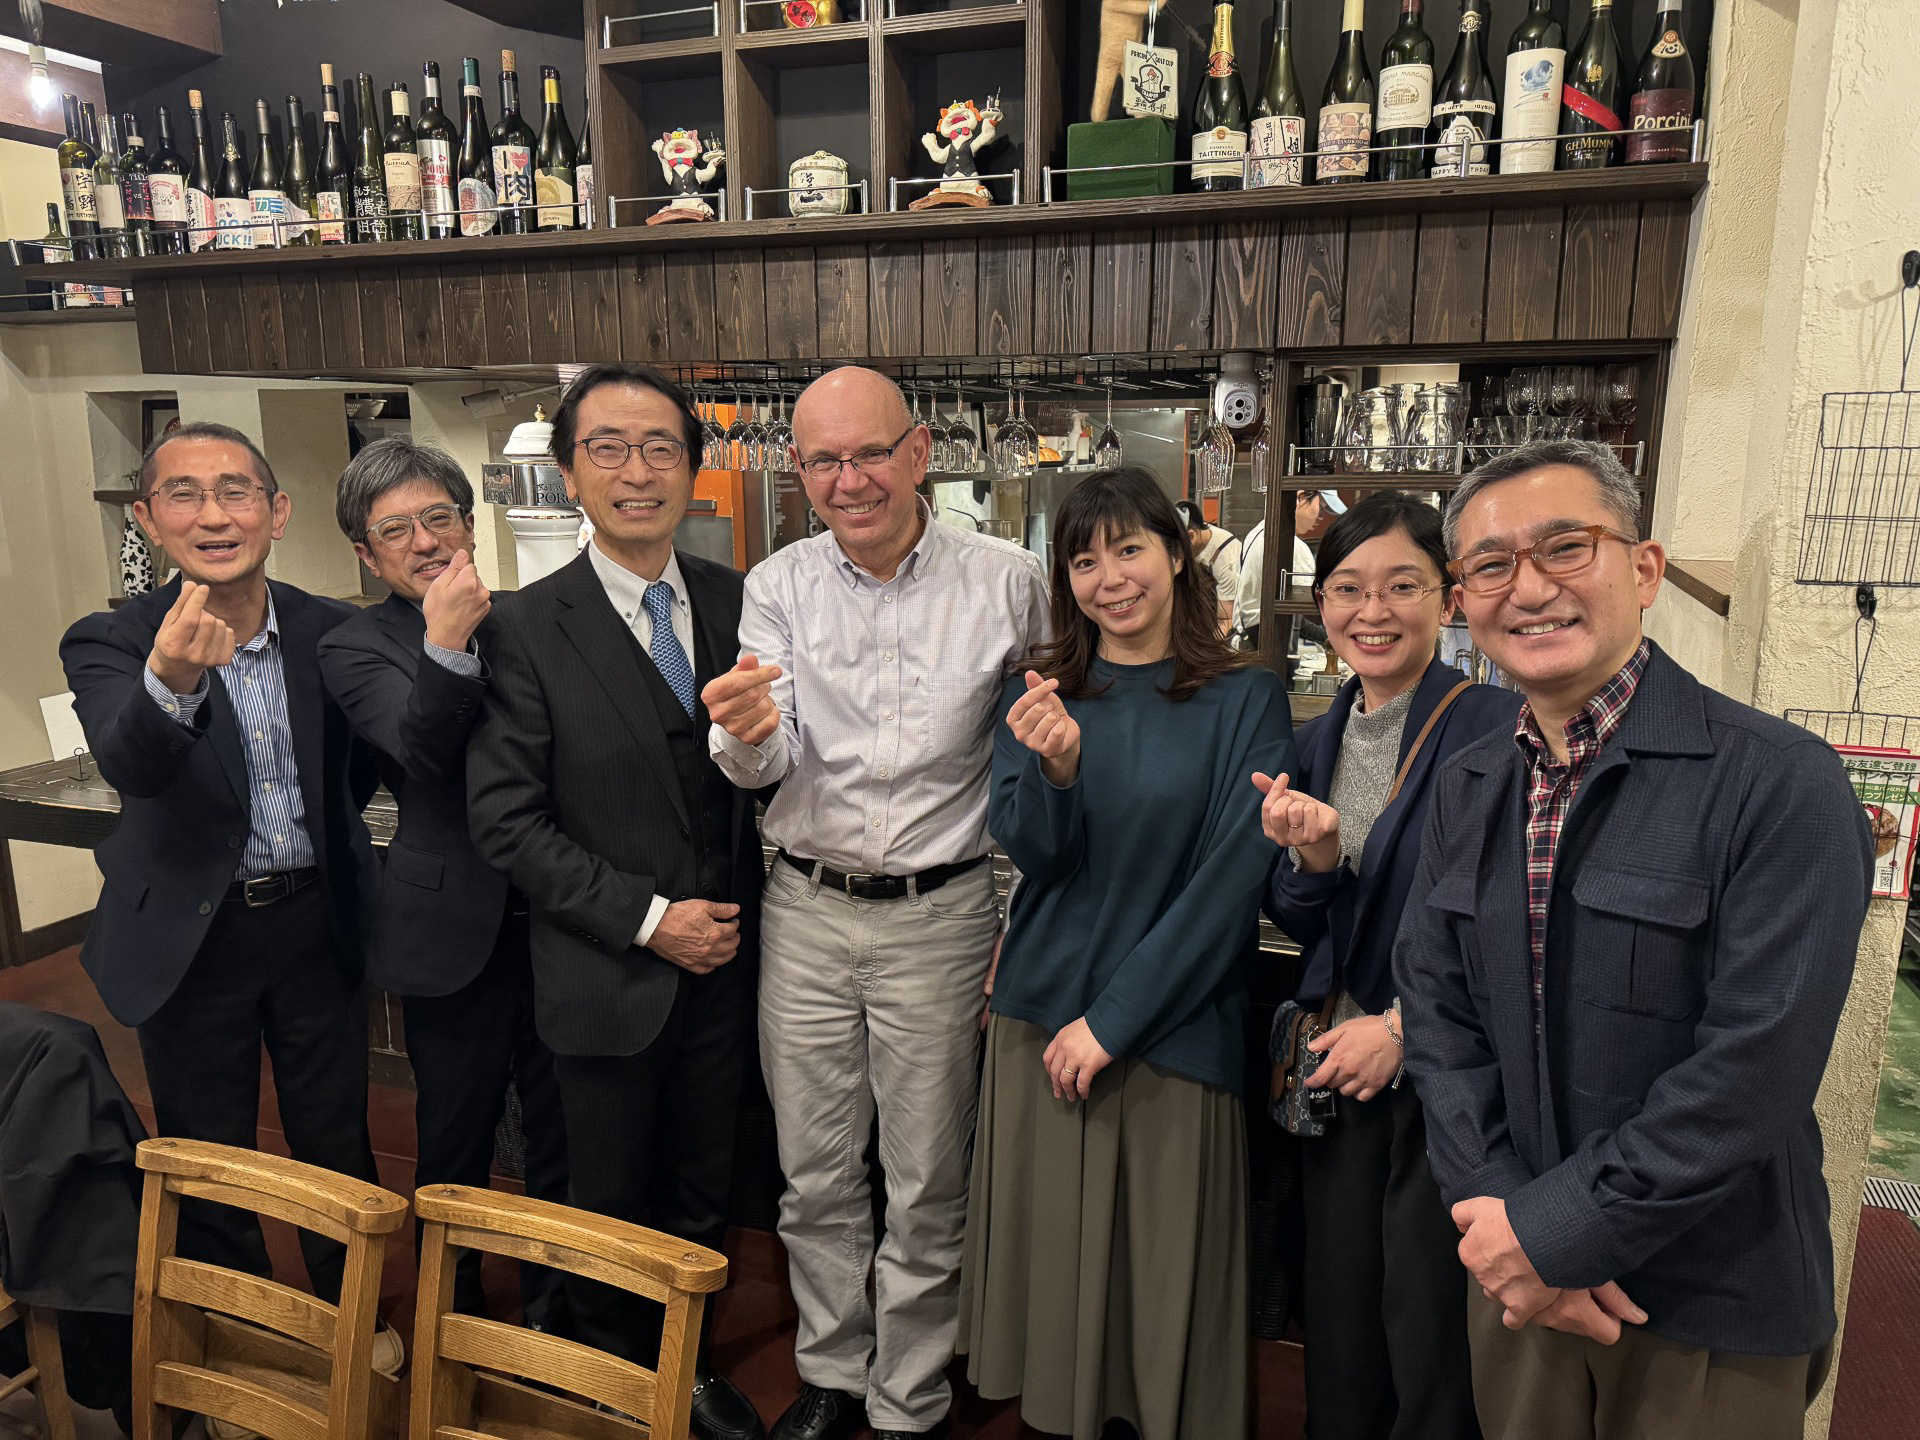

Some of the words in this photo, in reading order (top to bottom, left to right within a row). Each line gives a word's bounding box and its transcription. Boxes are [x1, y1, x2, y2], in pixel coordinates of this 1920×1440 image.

[1198, 150, 1242, 158] TAITTINGER
[504, 171, 531, 201] 肉
[354, 196, 388, 217] 消費者
[217, 233, 252, 246] UCK!!
